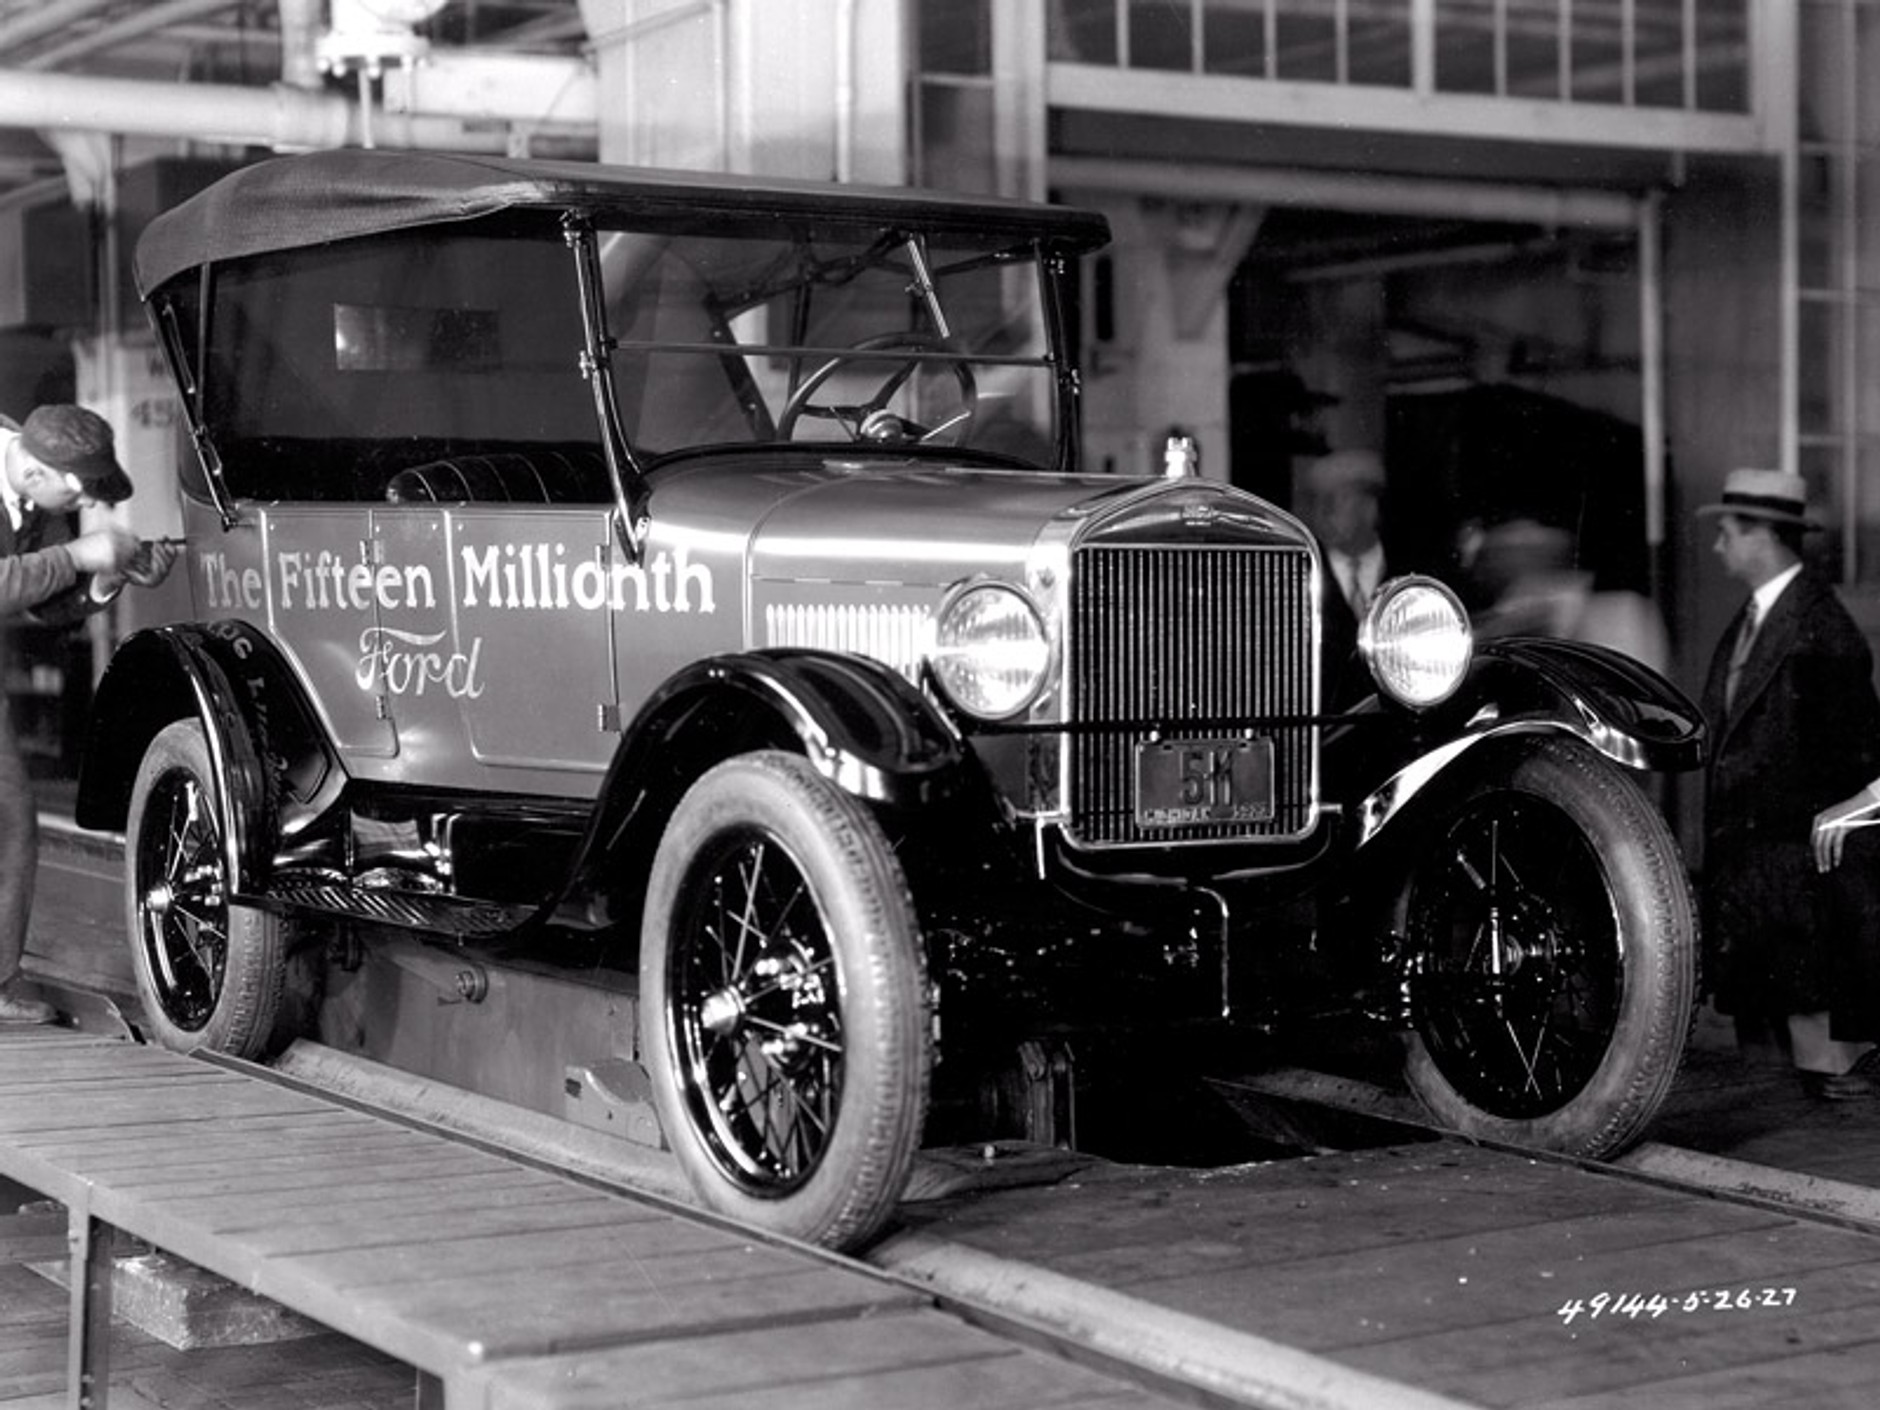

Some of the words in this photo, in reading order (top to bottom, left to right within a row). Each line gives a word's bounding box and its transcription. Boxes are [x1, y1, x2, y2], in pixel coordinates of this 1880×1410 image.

[201, 552, 262, 609] The
[278, 550, 436, 610] Fifteen
[461, 543, 716, 614] Millionth
[355, 626, 485, 699] Ford
